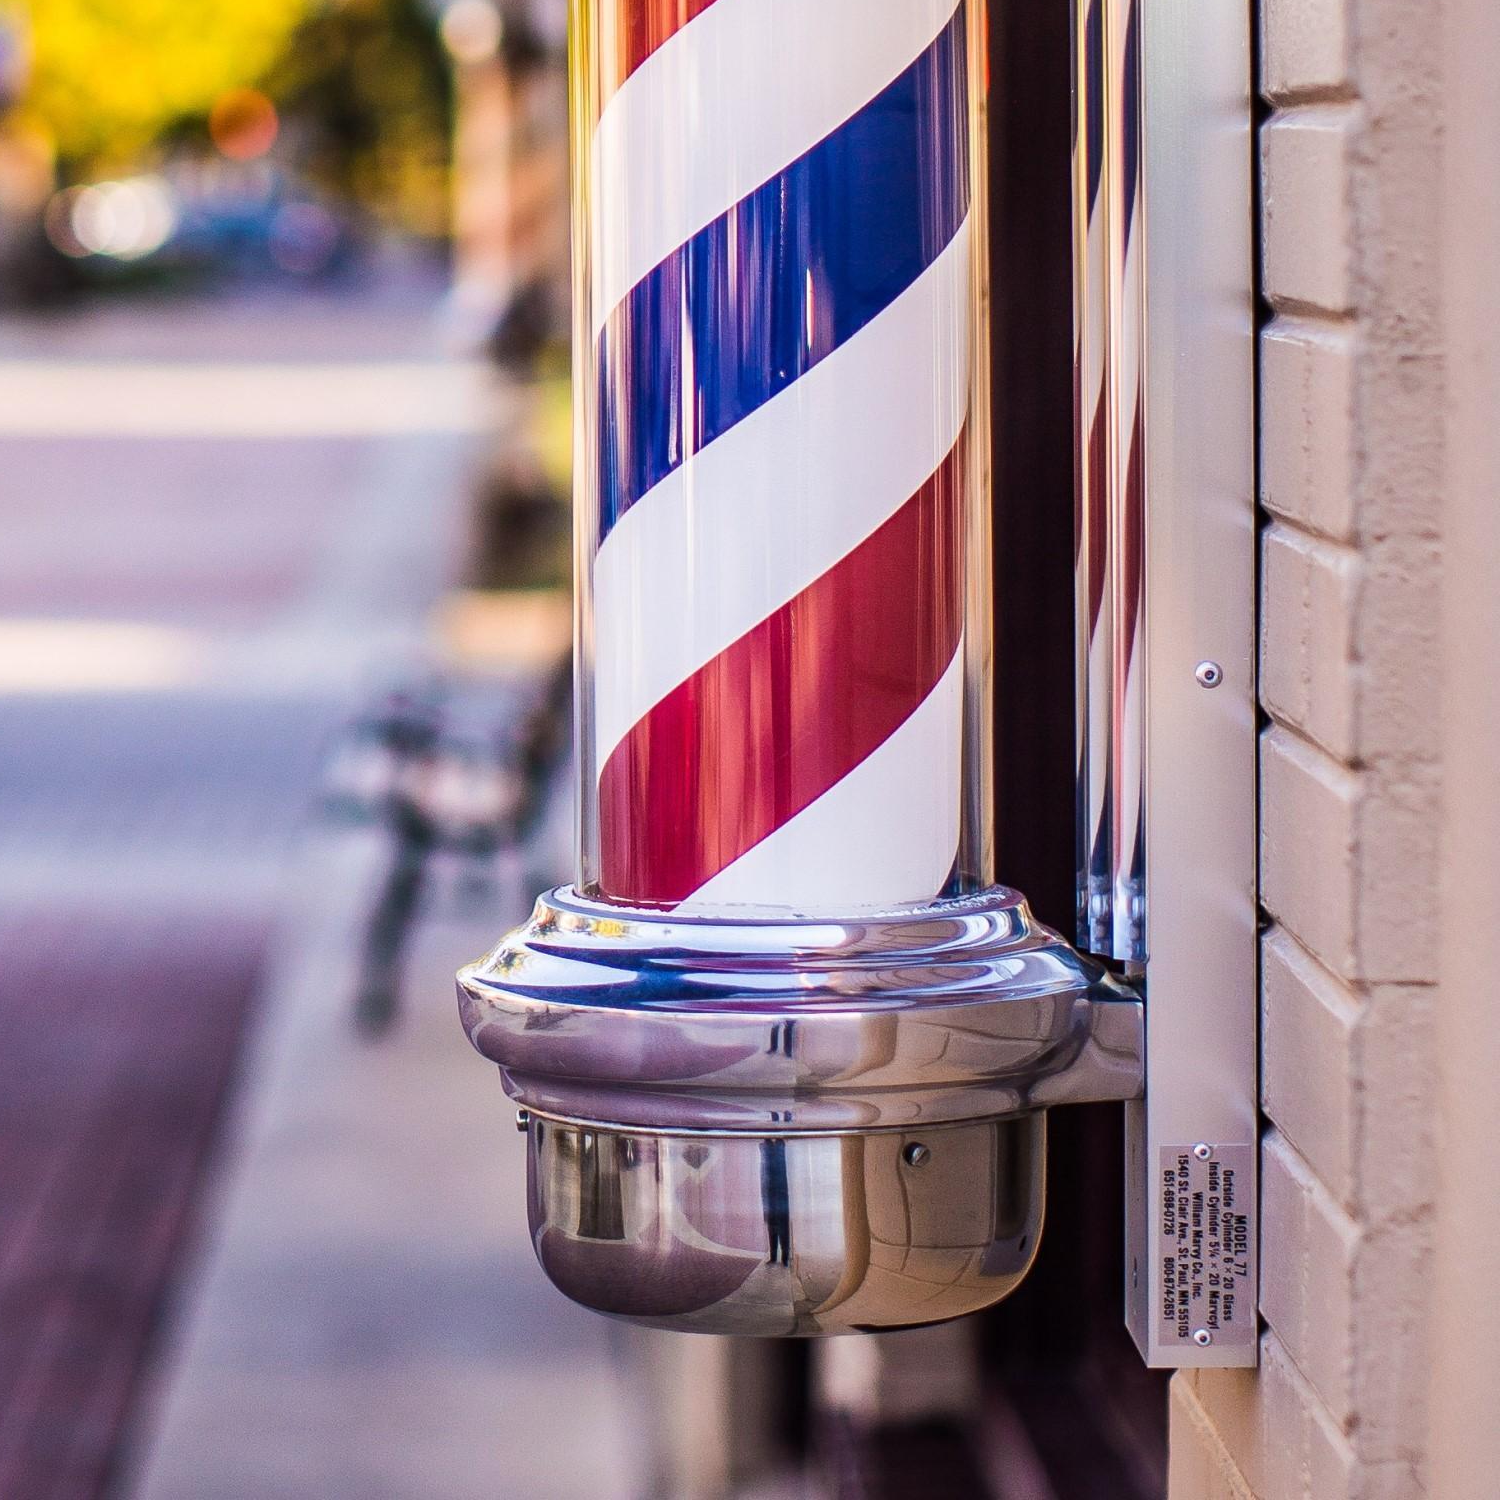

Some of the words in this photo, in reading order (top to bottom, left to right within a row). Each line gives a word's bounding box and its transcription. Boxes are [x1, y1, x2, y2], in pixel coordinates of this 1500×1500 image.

[1178, 1155, 1188, 1178] 1540
[1209, 1162, 1220, 1191] Inside
[1178, 1181, 1188, 1194] St.
[1223, 1170, 1234, 1207] Outside
[1164, 1170, 1175, 1235] 651-698-0726
[1178, 1197, 1188, 1219] Clair
[1193, 1192, 1203, 1227] William
[1207, 1196, 1220, 1236] Cylinder
[1177, 1222, 1188, 1244] Ave.,
[1190, 1230, 1203, 1259] Marvy
[1221, 1212, 1234, 1252] Cylinder
[1234, 1215, 1246, 1255] MODEL
[1178, 1248, 1188, 1260] St.
[1177, 1264, 1188, 1287] Paul,
[1191, 1262, 1203, 1280] Co.,
[1209, 1273, 1220, 1285] 20
[1234, 1262, 1246, 1276] 77
[1164, 1257, 1175, 1320] 800-874-2651
[1193, 1283, 1203, 1299] Inc.
[1223, 1277, 1234, 1289] 20
[1179, 1290, 1188, 1305] MN
[1207, 1291, 1220, 1329] Marvcyl
[1223, 1294, 1234, 1321] Glass
[1179, 1308, 1188, 1338] 55105
